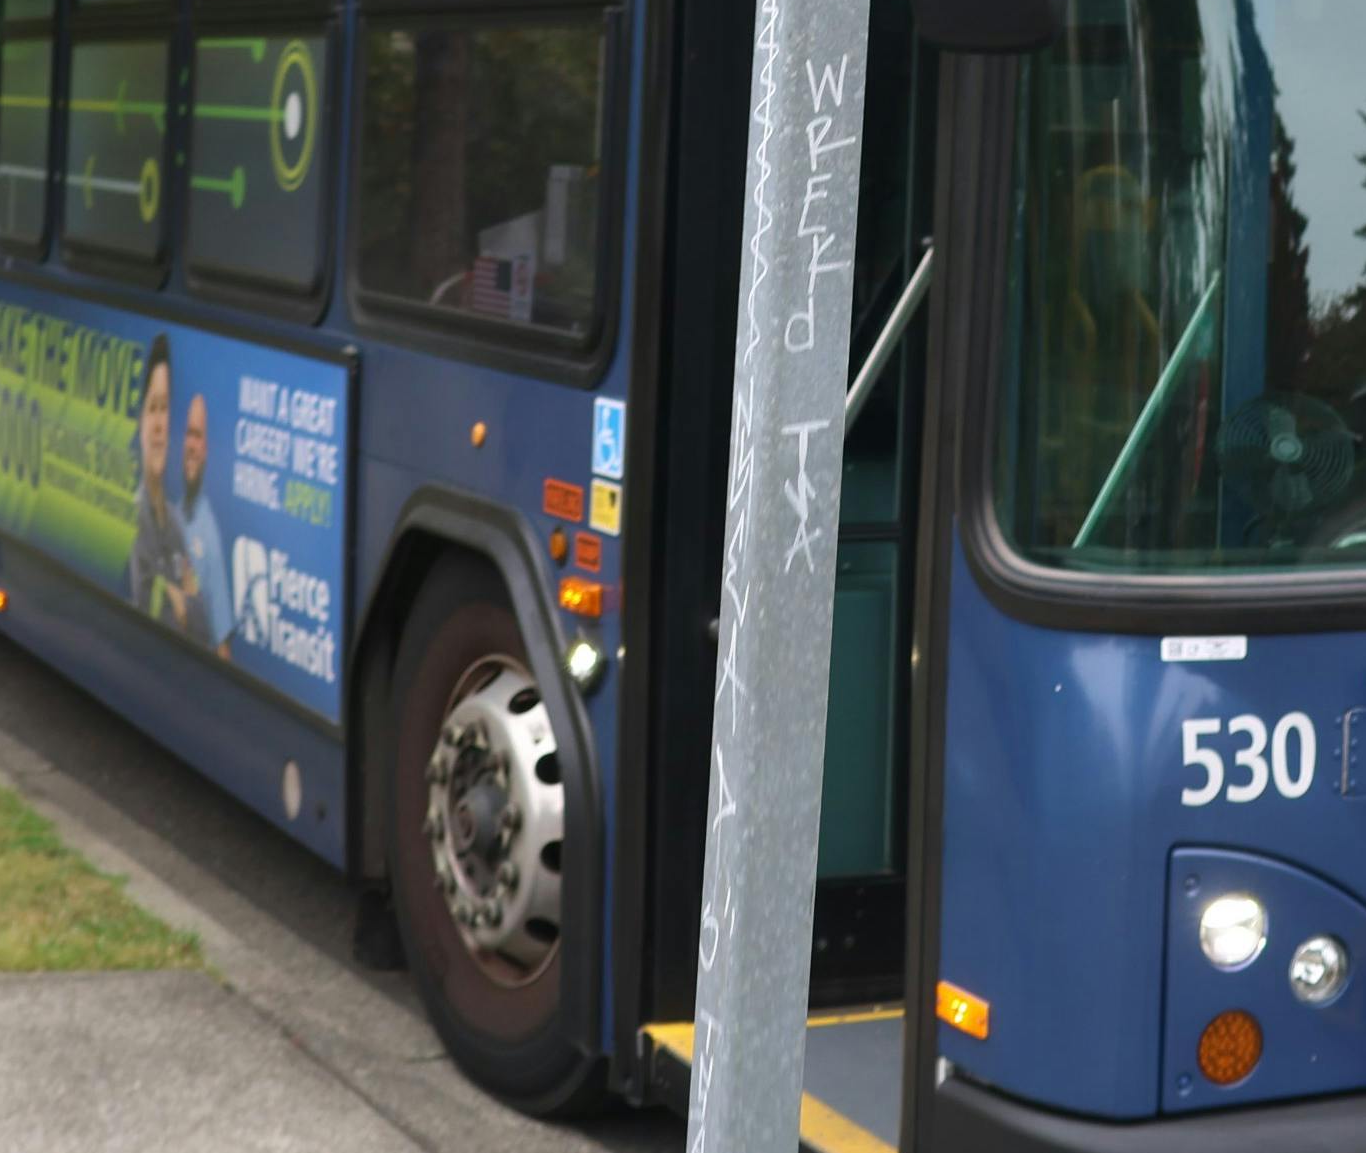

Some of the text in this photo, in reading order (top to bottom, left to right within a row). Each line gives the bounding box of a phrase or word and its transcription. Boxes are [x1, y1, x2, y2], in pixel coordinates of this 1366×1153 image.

[269, 547, 332, 623] Pierce
[268, 600, 336, 684] Transit
[1180, 710, 1318, 807] 530
